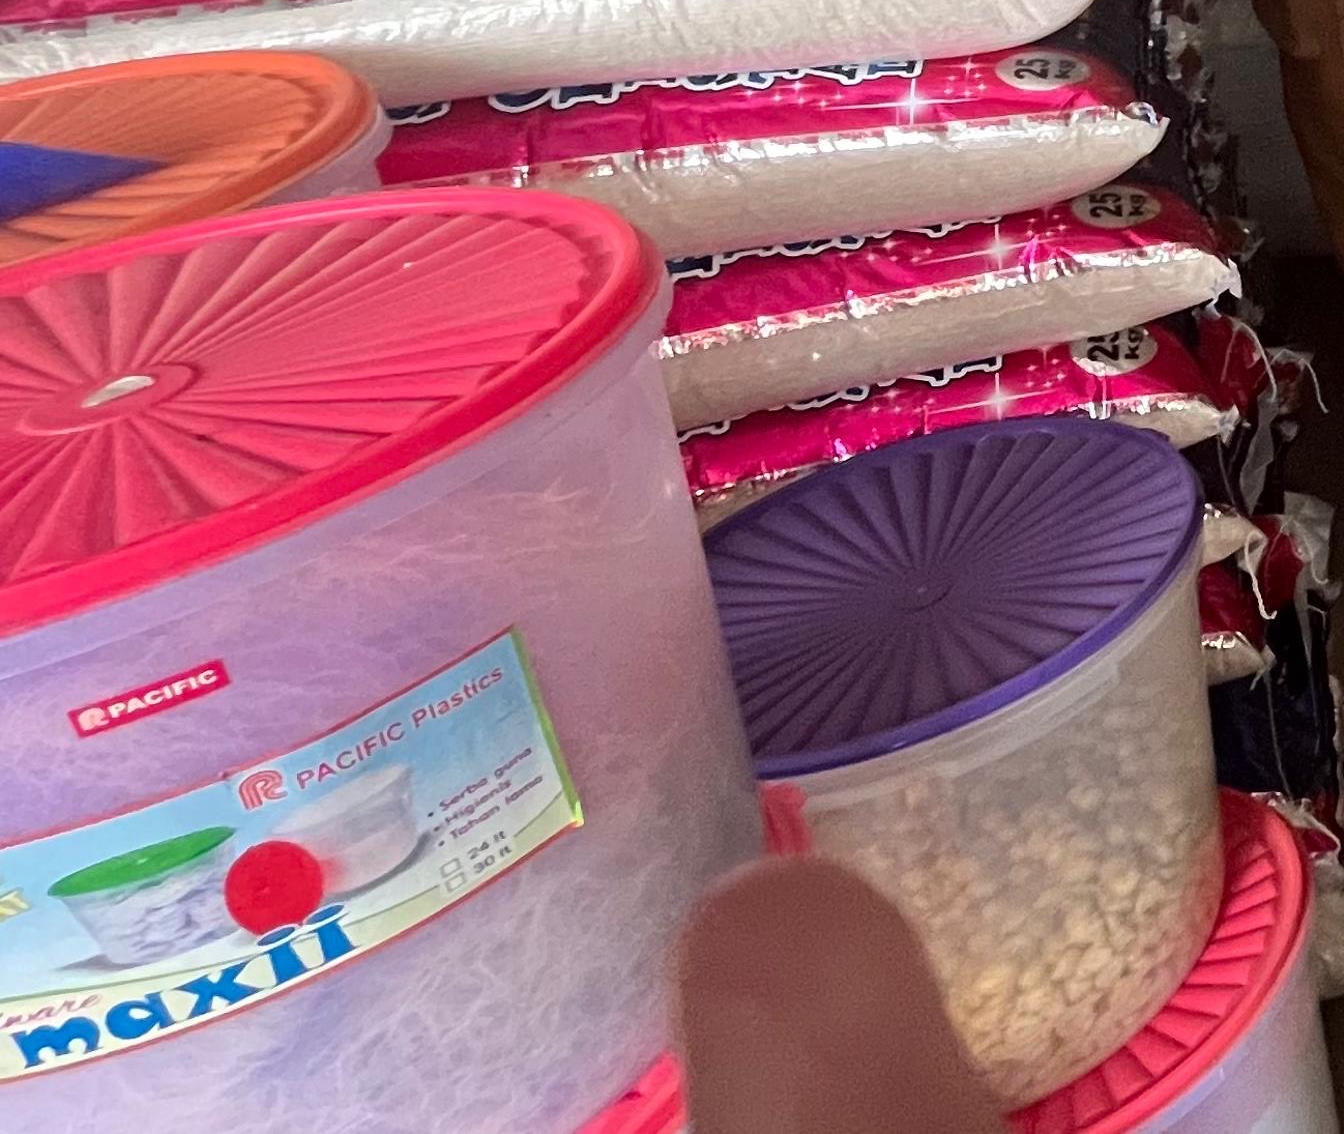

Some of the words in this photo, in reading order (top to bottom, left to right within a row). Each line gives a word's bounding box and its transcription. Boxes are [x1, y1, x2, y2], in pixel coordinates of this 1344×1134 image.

[1013, 56, 1050, 82] 25
[1054, 59, 1078, 80] kg
[1088, 192, 1124, 218] 25
[1128, 194, 1147, 217] kg
[107, 667, 219, 721] PACIFIC
[295, 721, 406, 791] PACIFIC
[410, 667, 505, 730] Plastics
[439, 777, 489, 812] Serba
[450, 805, 501, 839] Tahan
[467, 841, 490, 860] 24
[473, 854, 496, 875] 30
